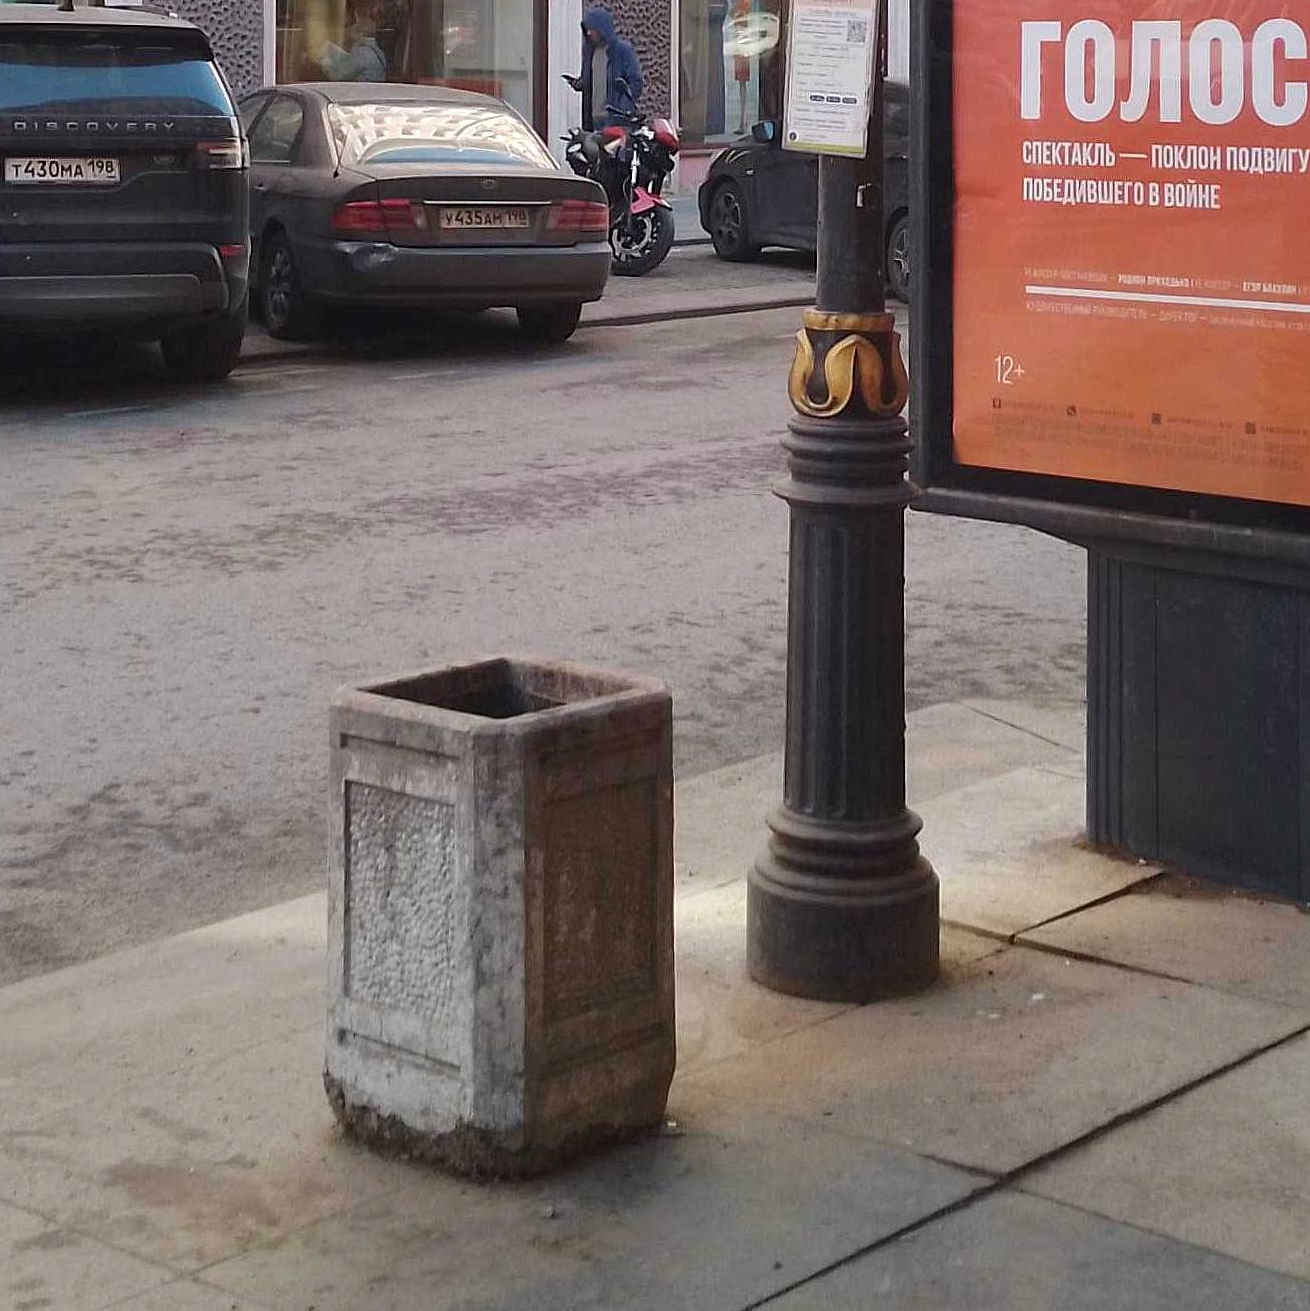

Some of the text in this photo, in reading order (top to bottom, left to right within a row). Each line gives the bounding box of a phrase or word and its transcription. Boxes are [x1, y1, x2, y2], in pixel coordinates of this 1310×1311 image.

[14, 121, 175, 132] DISCOVERY
[1022, 140, 1116, 167] СПЕКТАКЛЬ
[1151, 143, 1221, 170] ПОКЛОН
[1226, 146, 1310, 175] ПОДВИГУ
[1022, 177, 1222, 209] ПОБЕДИВШЕГО В ВОЙНЕ
[994, 354, 1026, 384] 12+
